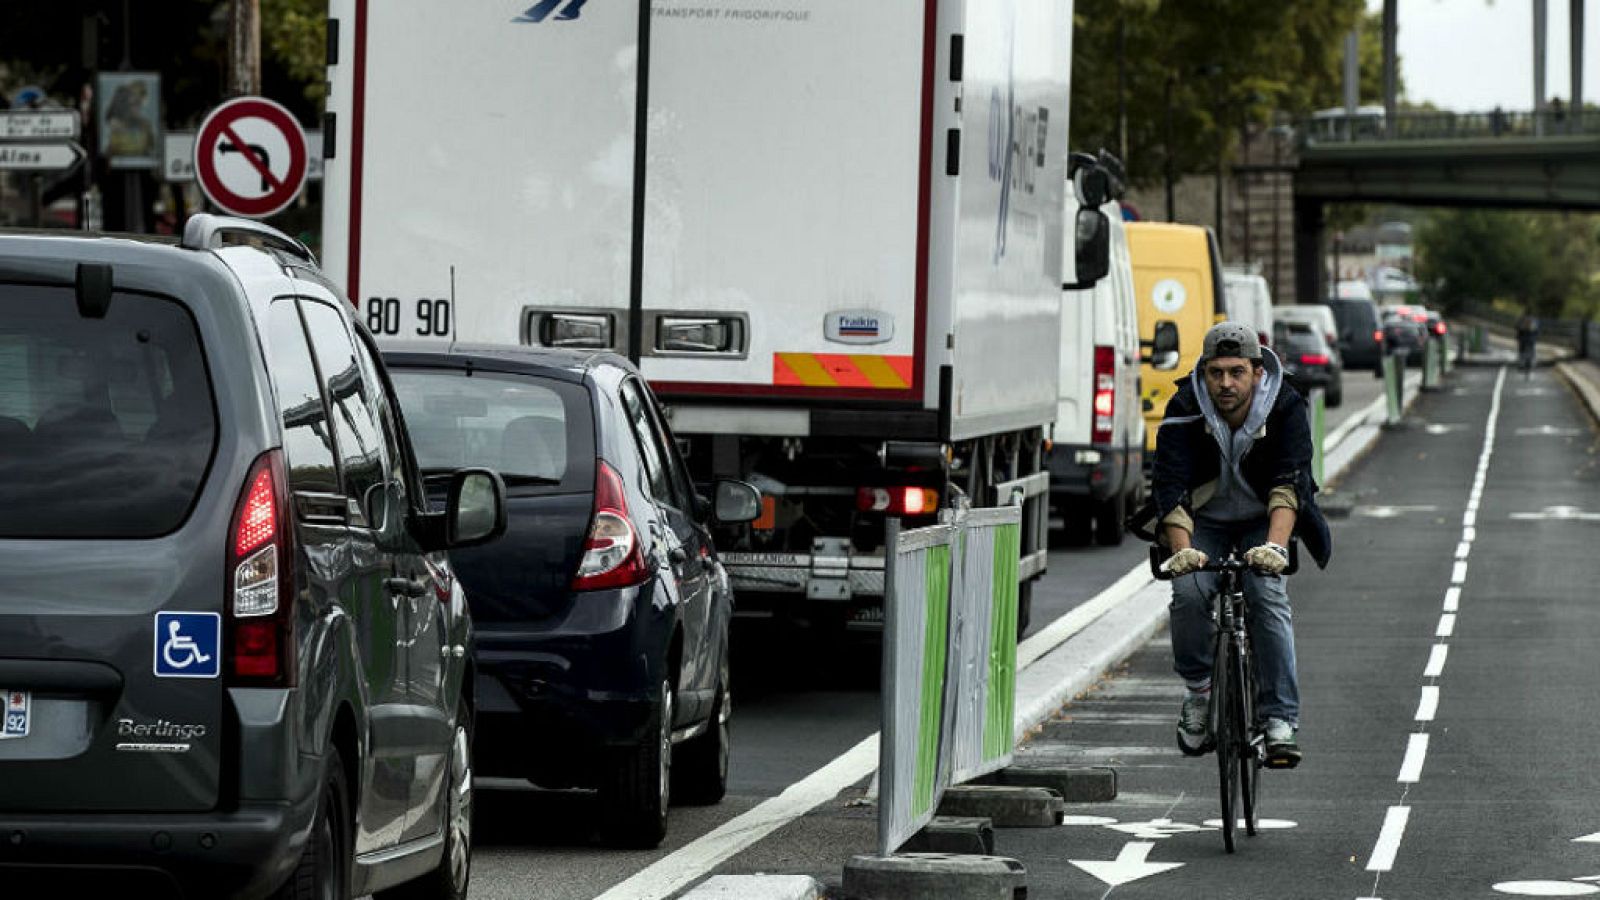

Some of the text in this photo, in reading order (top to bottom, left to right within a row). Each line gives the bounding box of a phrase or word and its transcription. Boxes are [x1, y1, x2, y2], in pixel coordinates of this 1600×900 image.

[650, 8, 811, 20] TRANSPORT FRIGORIFIQUE
[367, 298, 449, 336] 80 90
[8, 714, 25, 731] 92
[118, 719, 206, 740] Berlingo
